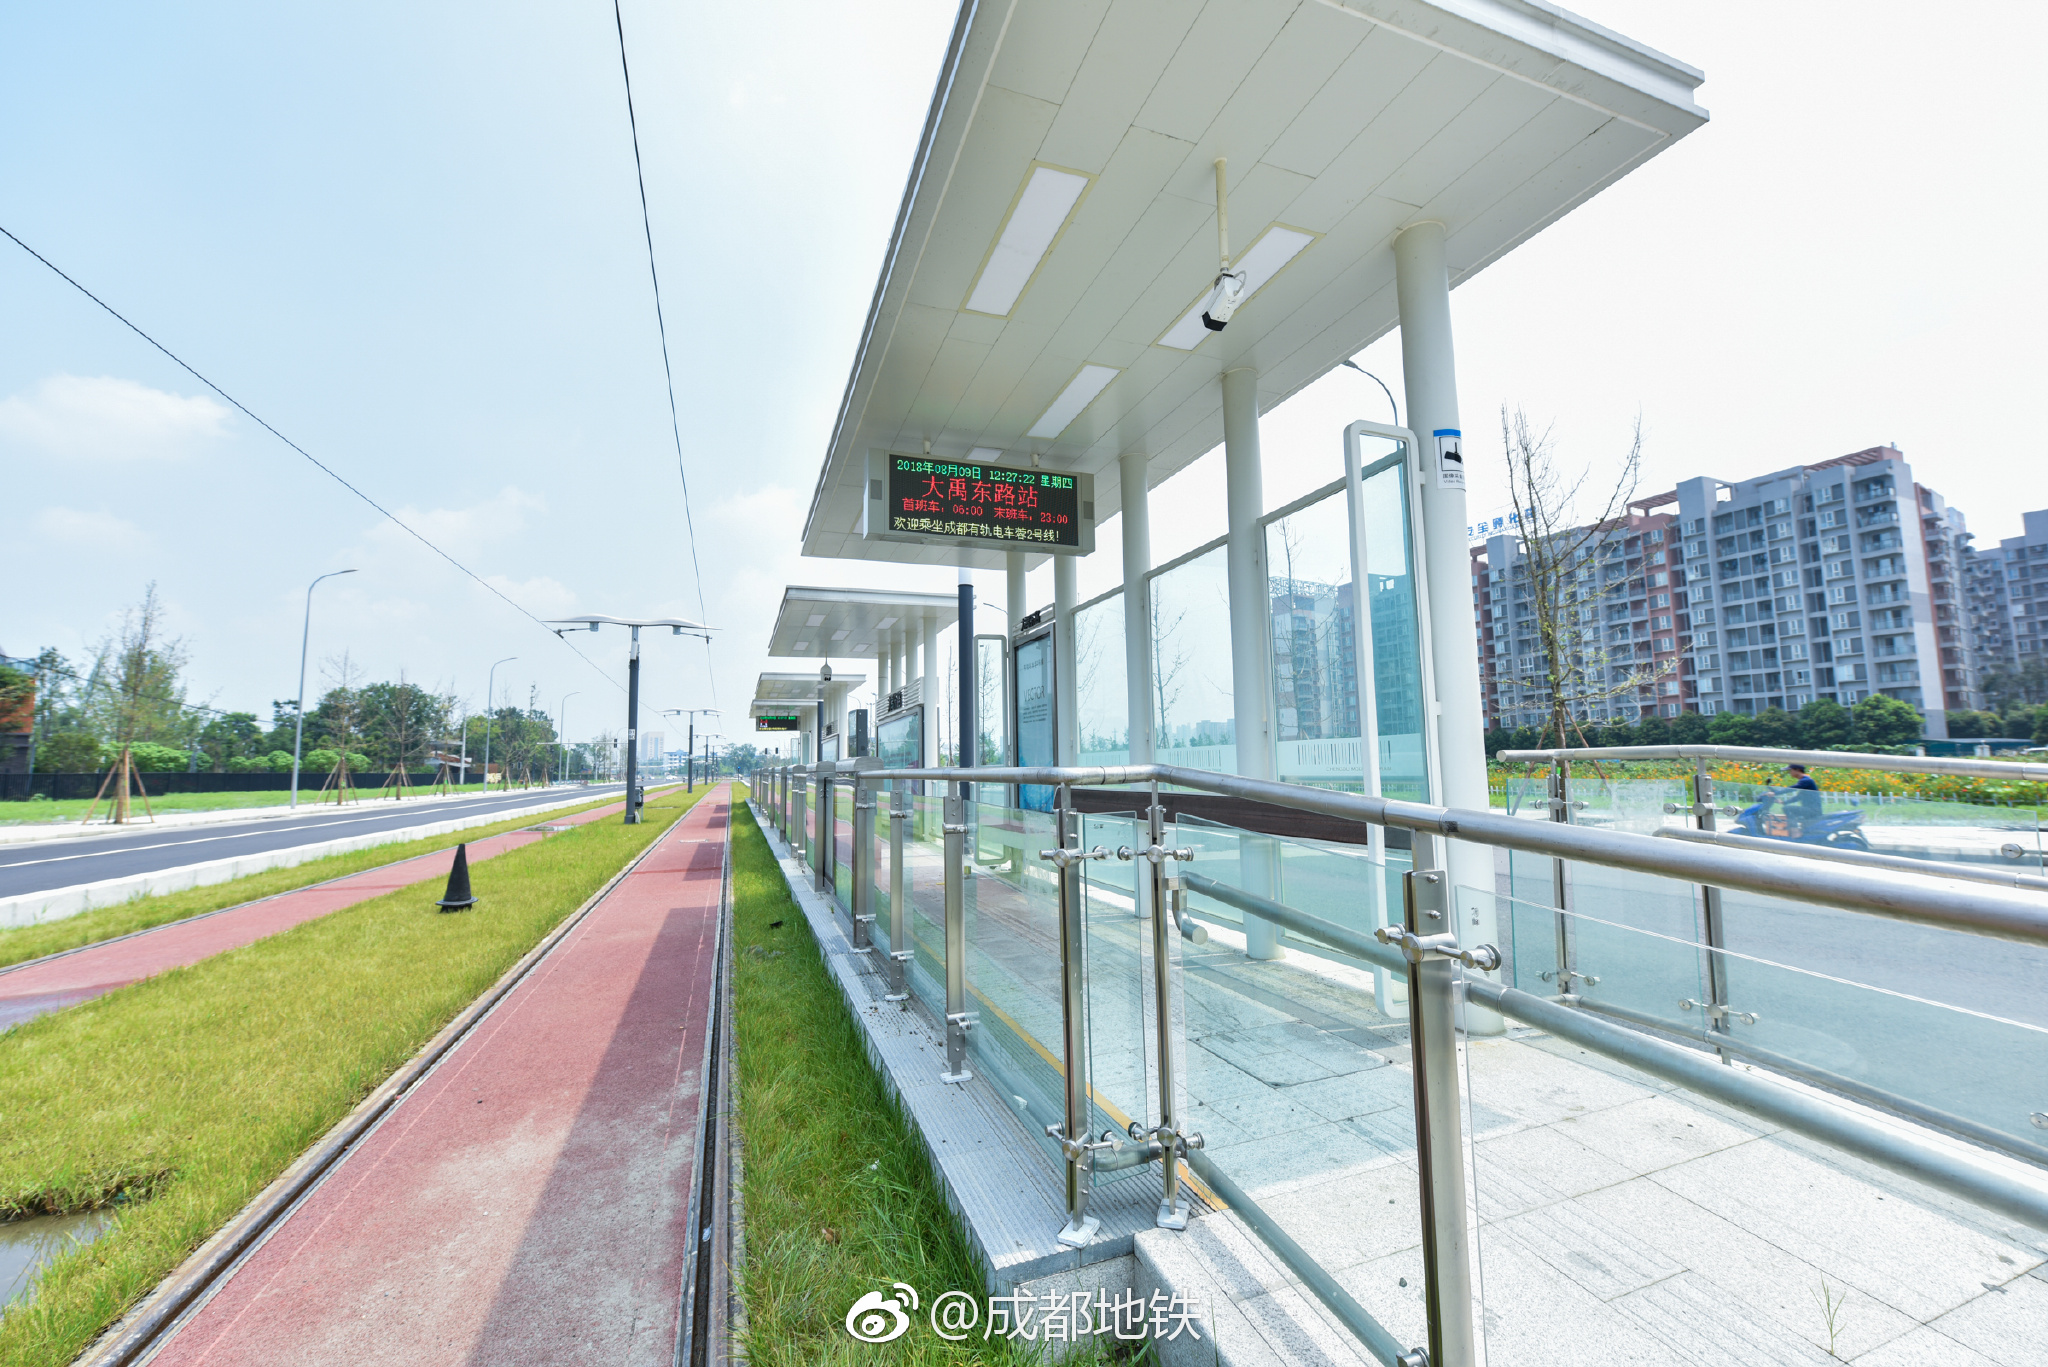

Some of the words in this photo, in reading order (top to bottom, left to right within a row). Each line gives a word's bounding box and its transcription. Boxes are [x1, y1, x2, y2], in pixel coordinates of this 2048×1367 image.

[897, 460, 981, 480] 2018年08月09日
[989, 470, 1035, 484] 12:27:22
[1040, 475, 1073, 489] 星期四
[922, 475, 1039, 508] 大禹东路站
[953, 504, 983, 516] 06:00
[1040, 512, 1068, 524] 23:00
